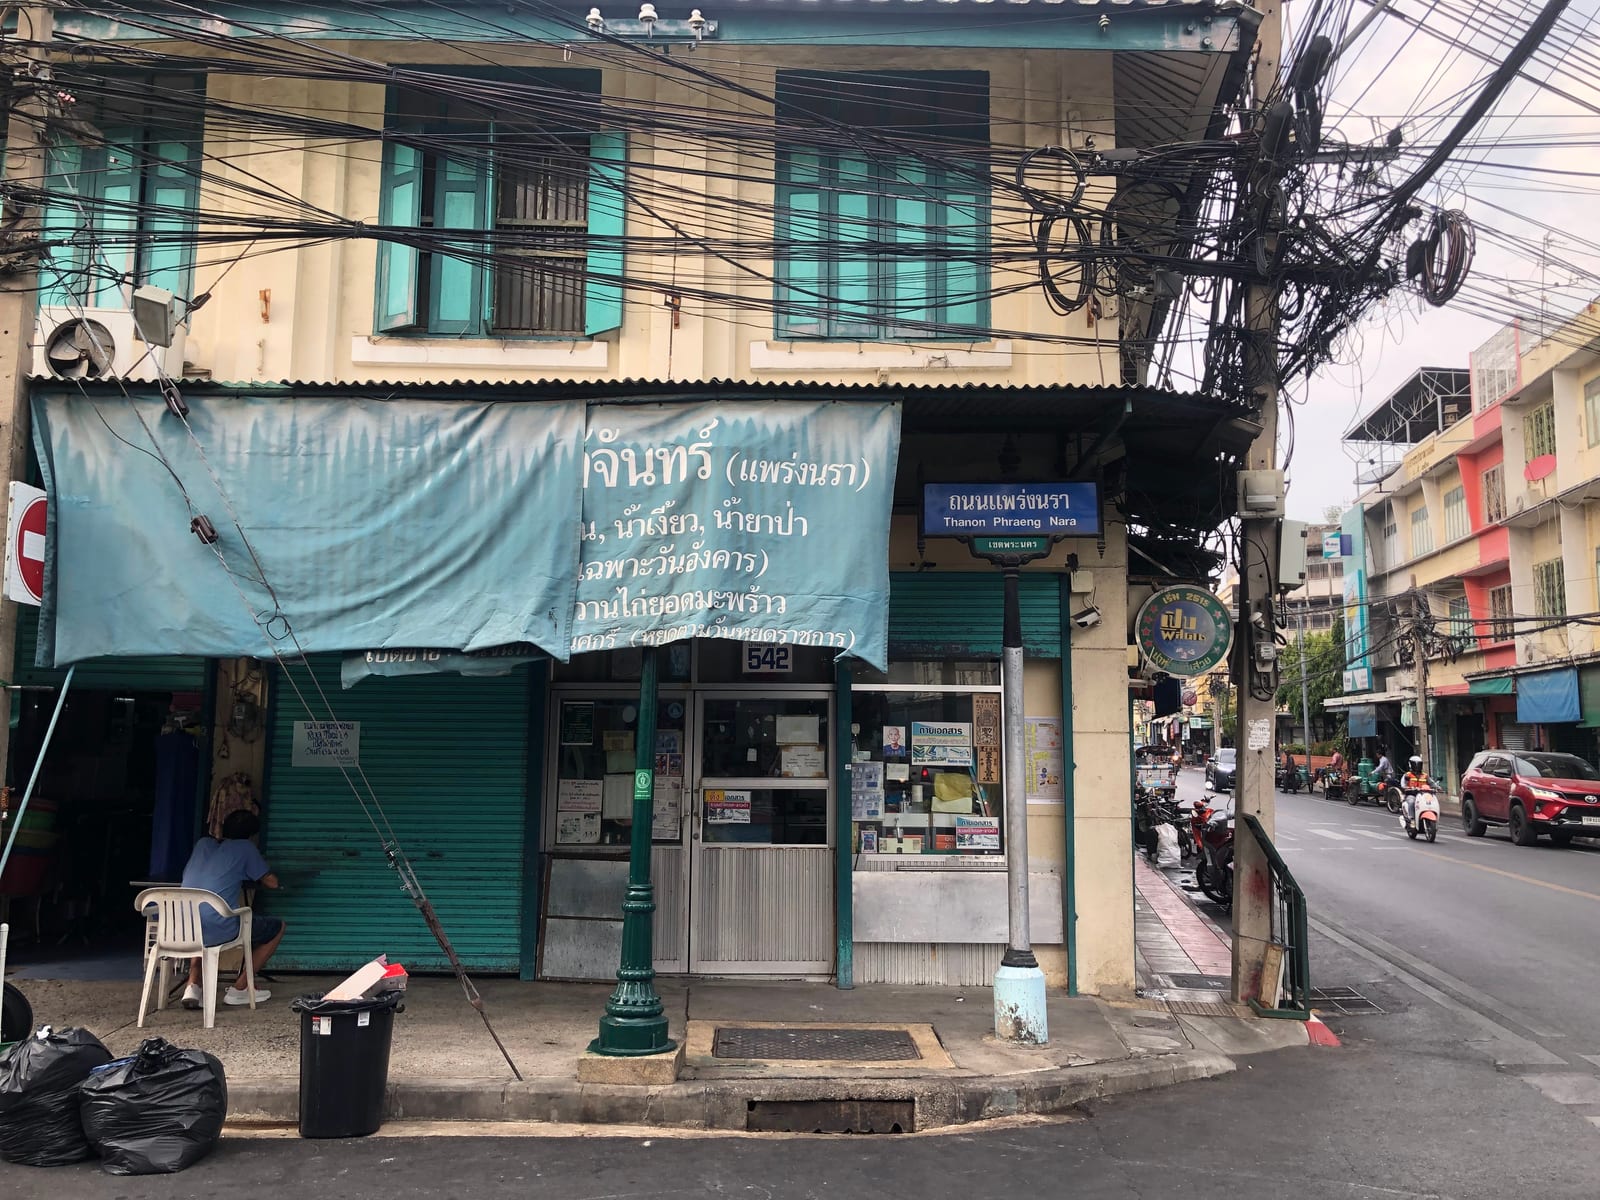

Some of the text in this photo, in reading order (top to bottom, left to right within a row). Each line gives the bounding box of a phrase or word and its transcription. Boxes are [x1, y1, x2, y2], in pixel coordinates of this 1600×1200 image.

[726, 452, 870, 492] (แพร่งนรา)
[949, 489, 1070, 511] ถนนแพร่งนรา
[713, 497, 808, 536] น้ำยาป่า
[944, 517, 1077, 528] Thanon Phraeng Nara
[748, 648, 788, 669] 542
